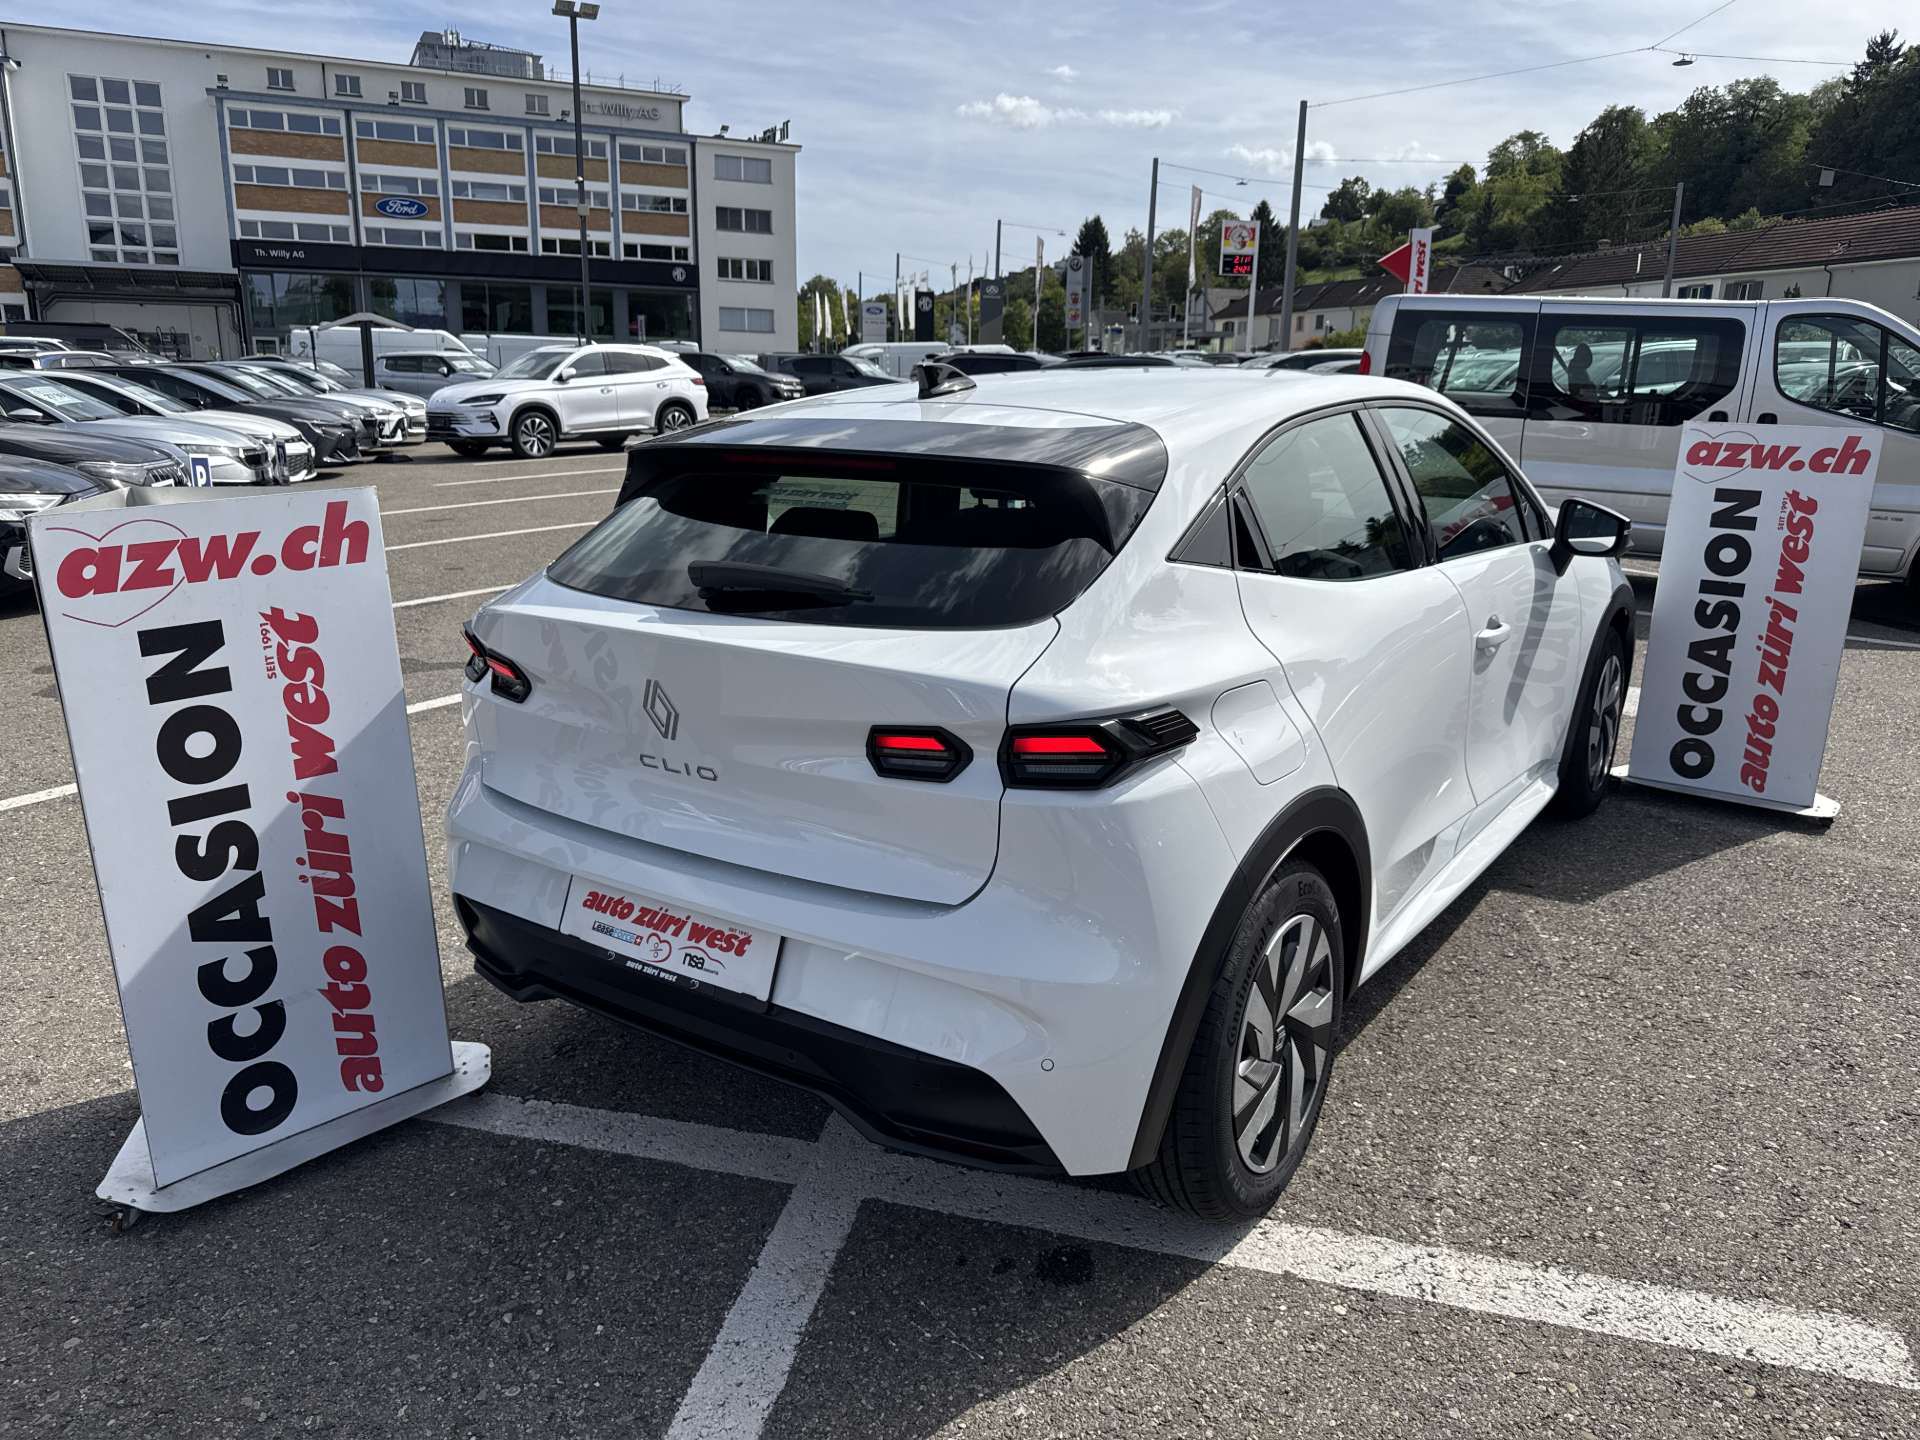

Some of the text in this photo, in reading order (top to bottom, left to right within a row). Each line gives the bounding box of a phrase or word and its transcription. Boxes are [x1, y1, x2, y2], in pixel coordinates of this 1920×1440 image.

[600, 103, 633, 121] Willy
[638, 106, 661, 120] AG
[385, 199, 418, 215] Ford
[254, 248, 305, 260] Th. Willy AG
[1416, 239, 1427, 278] west
[1686, 435, 1872, 475] azw.ch
[196, 465, 206, 487] P
[1777, 515, 1785, 531] SEIT
[57, 500, 370, 598] azw.ch
[260, 621, 278, 680] SEIT 1991
[1669, 488, 1763, 779] OCCASION
[1740, 489, 1819, 794] auto züri west
[640, 753, 718, 782] CLIO
[258, 606, 385, 1093] auto züri west
[137, 619, 298, 1136] OCCASION
[582, 890, 753, 957] auto züri west
[625, 960, 642, 971] auto
[659, 970, 678, 983] west
[682, 952, 705, 970] nsa
